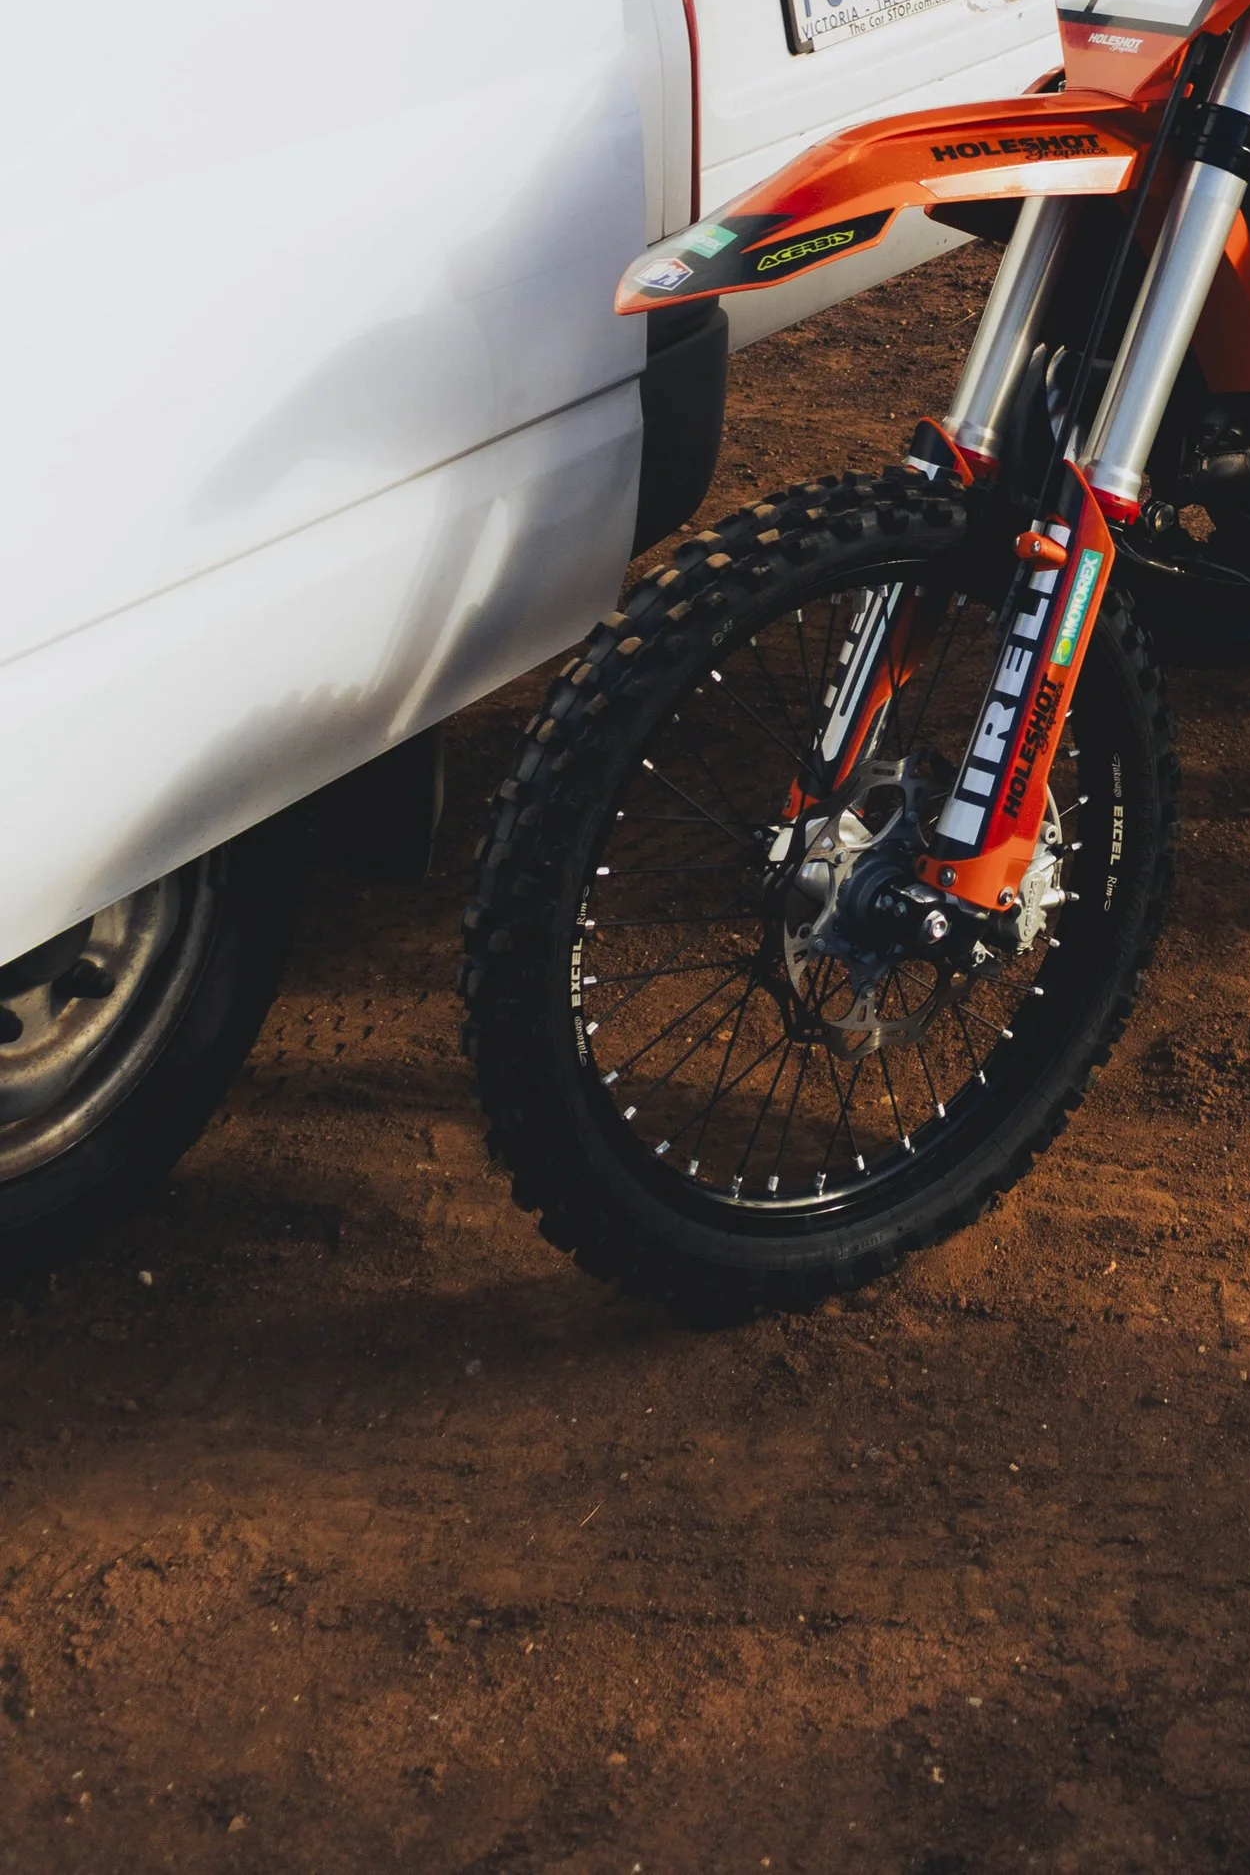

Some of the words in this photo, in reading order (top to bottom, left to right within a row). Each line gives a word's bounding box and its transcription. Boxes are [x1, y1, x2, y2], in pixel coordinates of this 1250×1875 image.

[802, 7, 859, 39] VICTORIA
[849, 22, 866, 37] The
[869, 14, 885, 29] Car
[1088, 32, 1144, 49] HOLESHOT
[929, 134, 1098, 162] HOLESHOT
[1061, 554, 1099, 640] MOTOREX
[1003, 672, 1057, 819] HOLESHOT
[1109, 805, 1124, 866] EXCEL
[1104, 875, 1118, 905] Rim
[576, 892, 589, 925] Rim
[570, 937, 583, 1009] EXCEL
